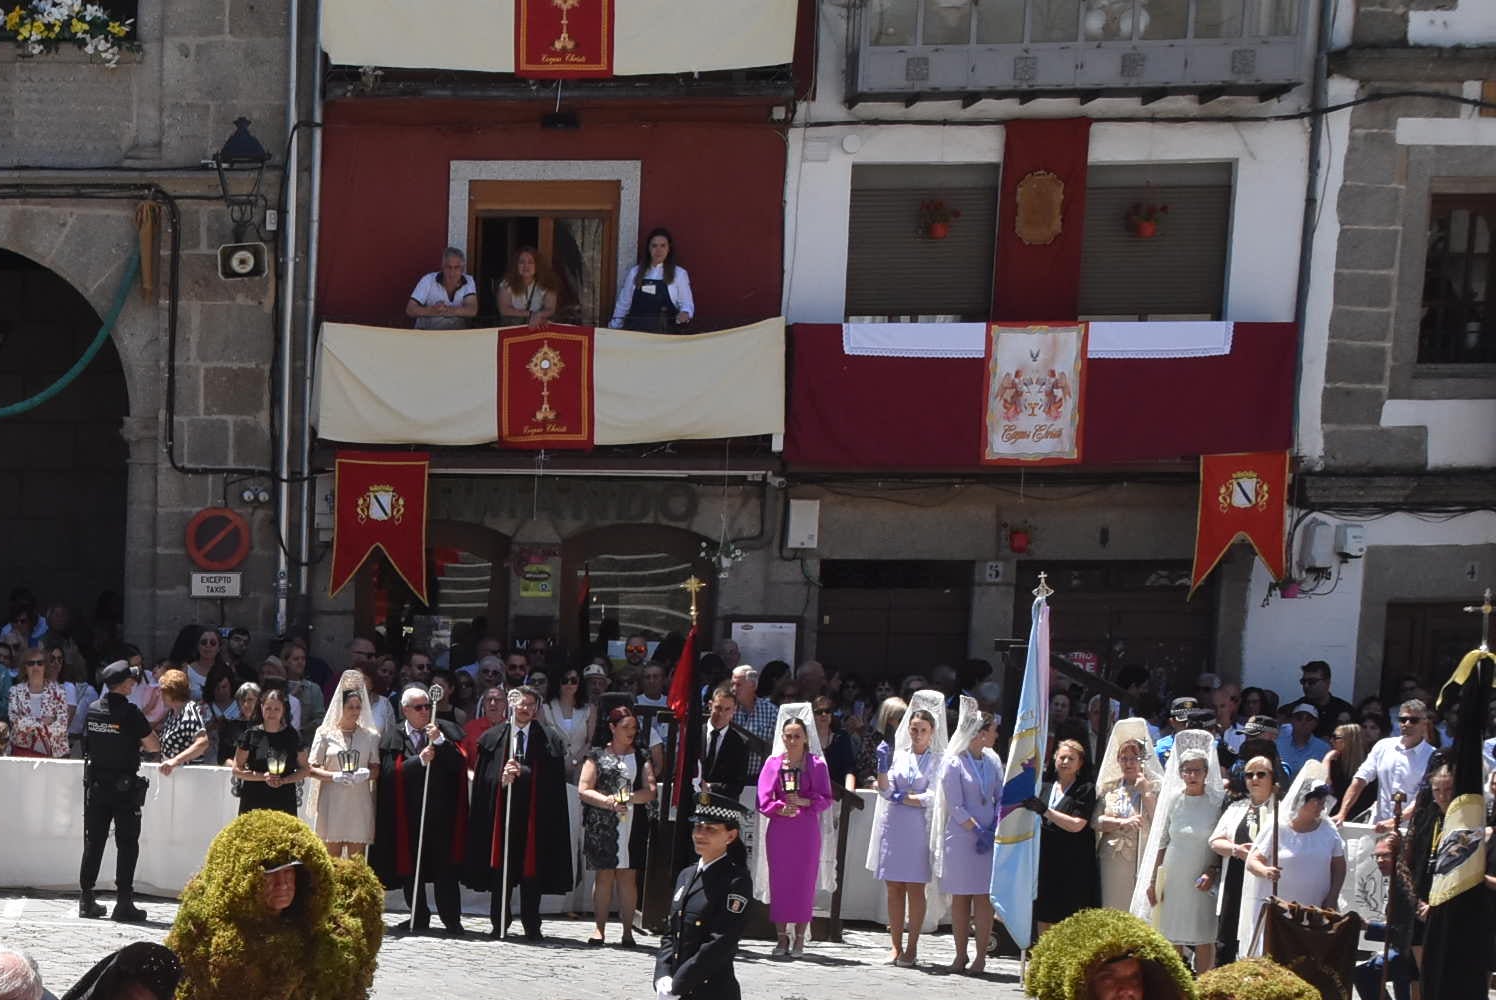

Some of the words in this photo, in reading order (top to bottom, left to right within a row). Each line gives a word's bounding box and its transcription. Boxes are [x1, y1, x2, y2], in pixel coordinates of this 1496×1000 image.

[988, 564, 1000, 580] 5
[1466, 564, 1476, 580] 4
[200, 575, 232, 584] EXCEPTO
[206, 585, 226, 593] TAXIS
